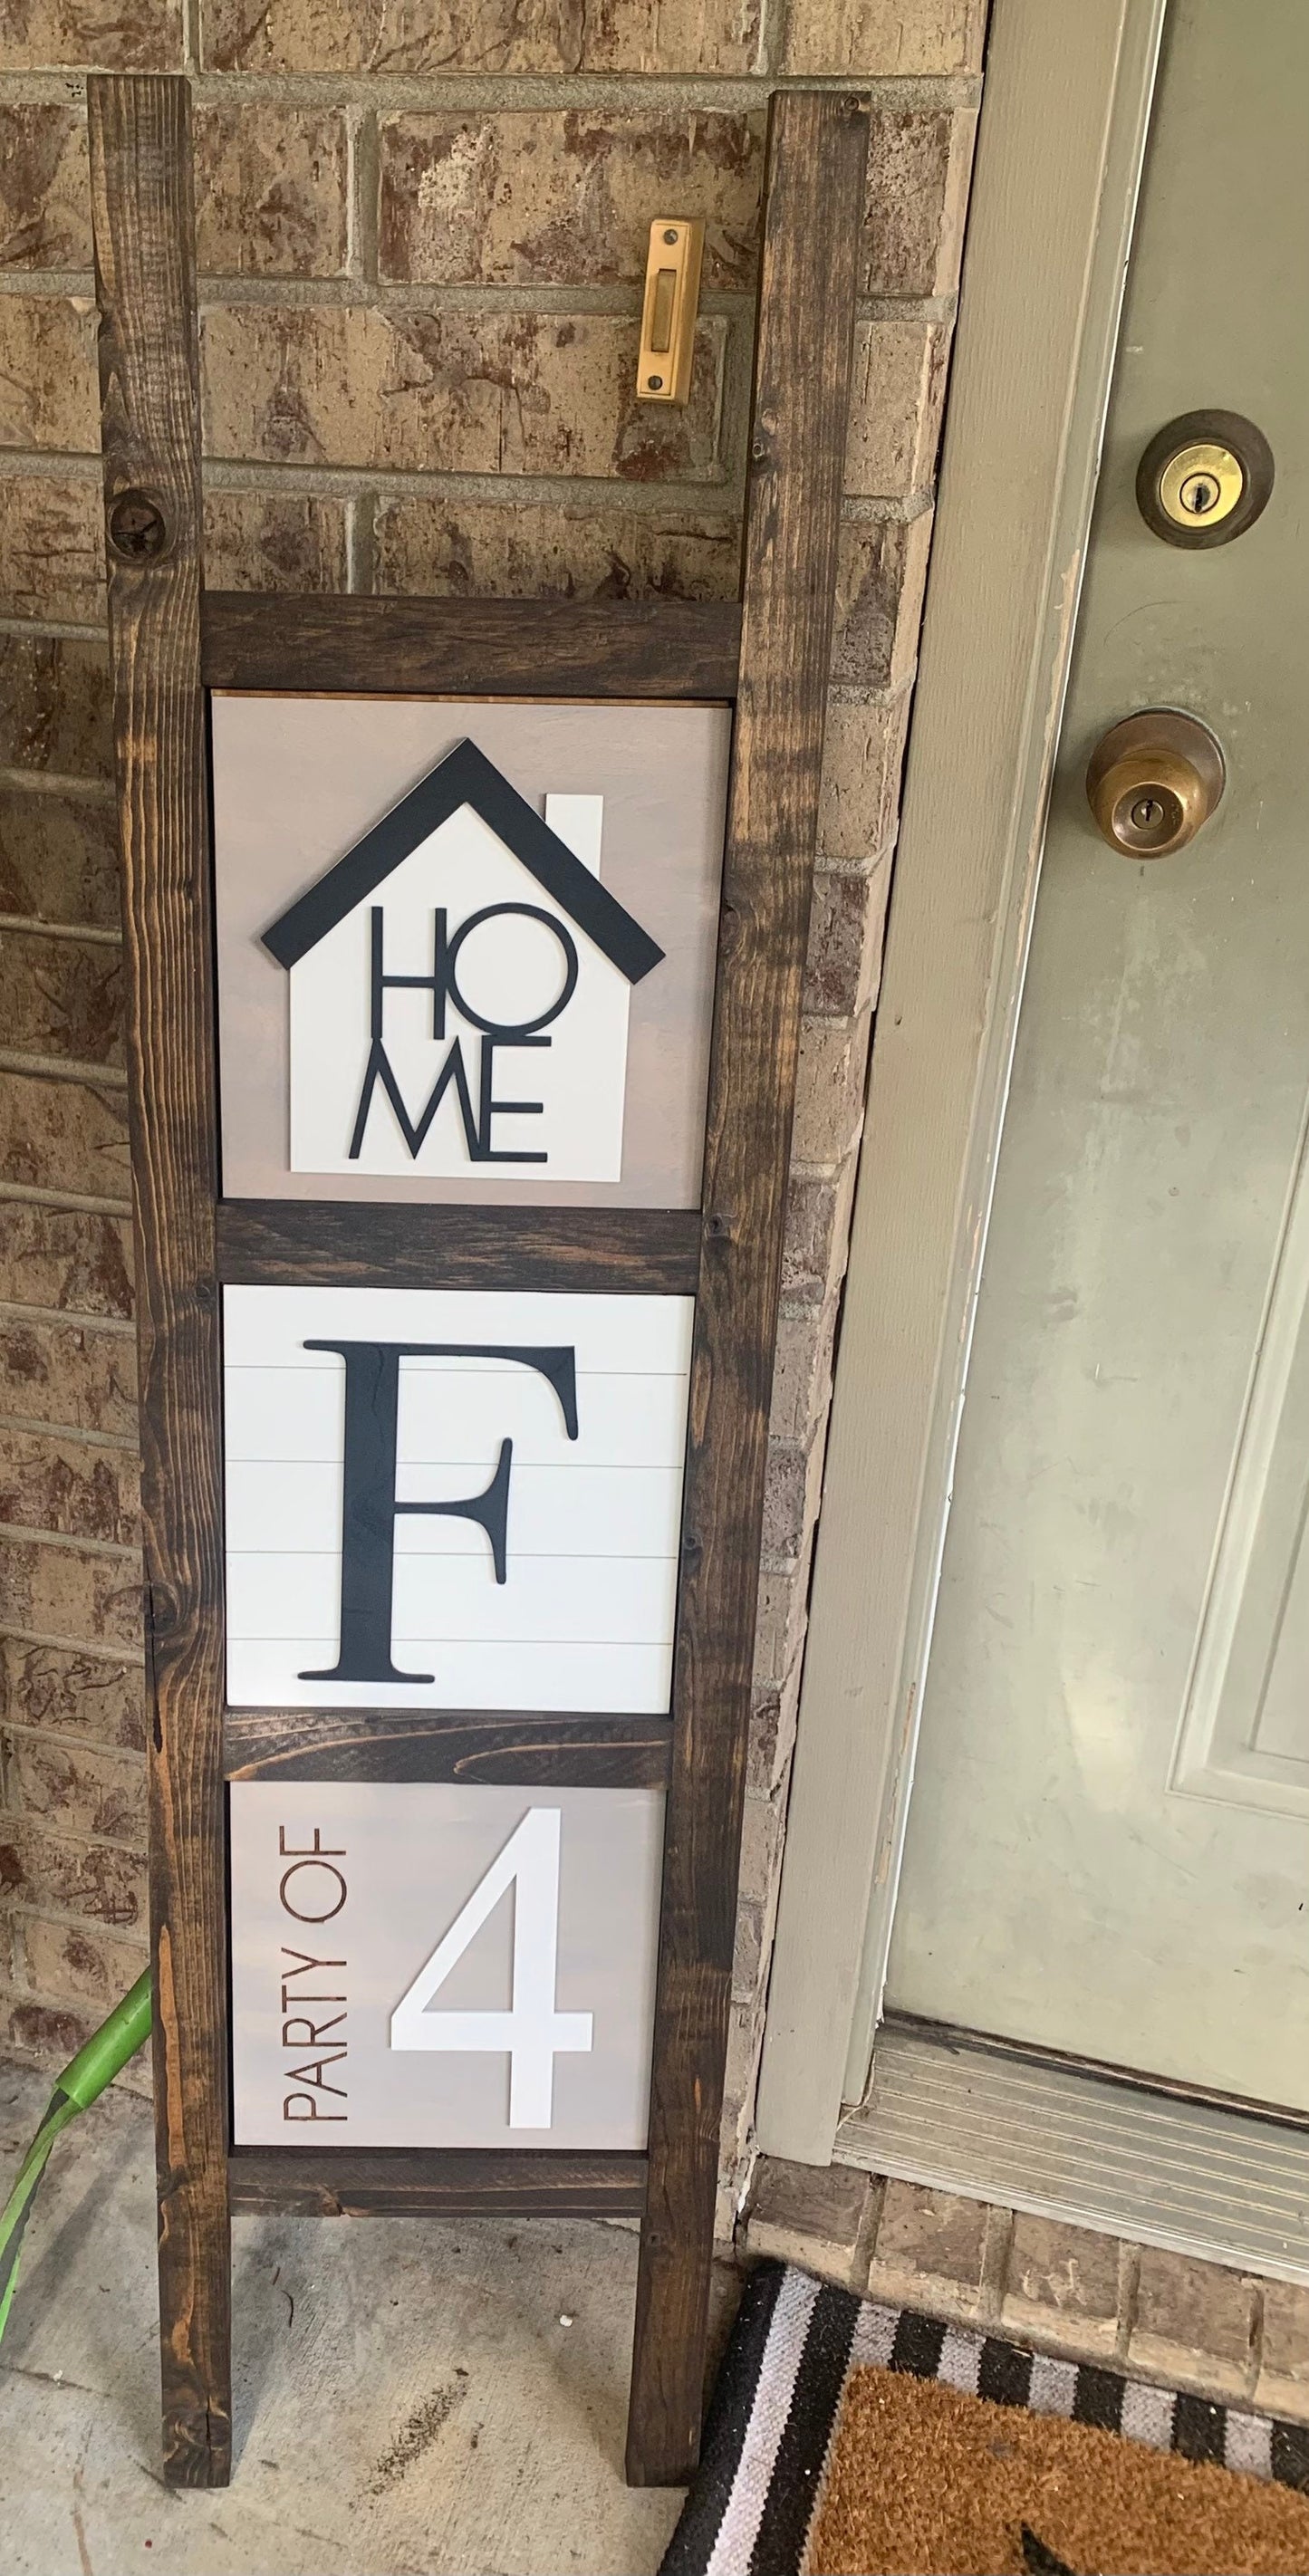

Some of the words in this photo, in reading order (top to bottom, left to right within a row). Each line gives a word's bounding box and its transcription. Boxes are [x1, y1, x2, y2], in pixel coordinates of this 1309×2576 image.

[298, 1340, 579, 1684] F
[279, 1825, 348, 1924] OF
[390, 1807, 593, 2129] 4
[281, 1946, 348, 2122] PARTY
